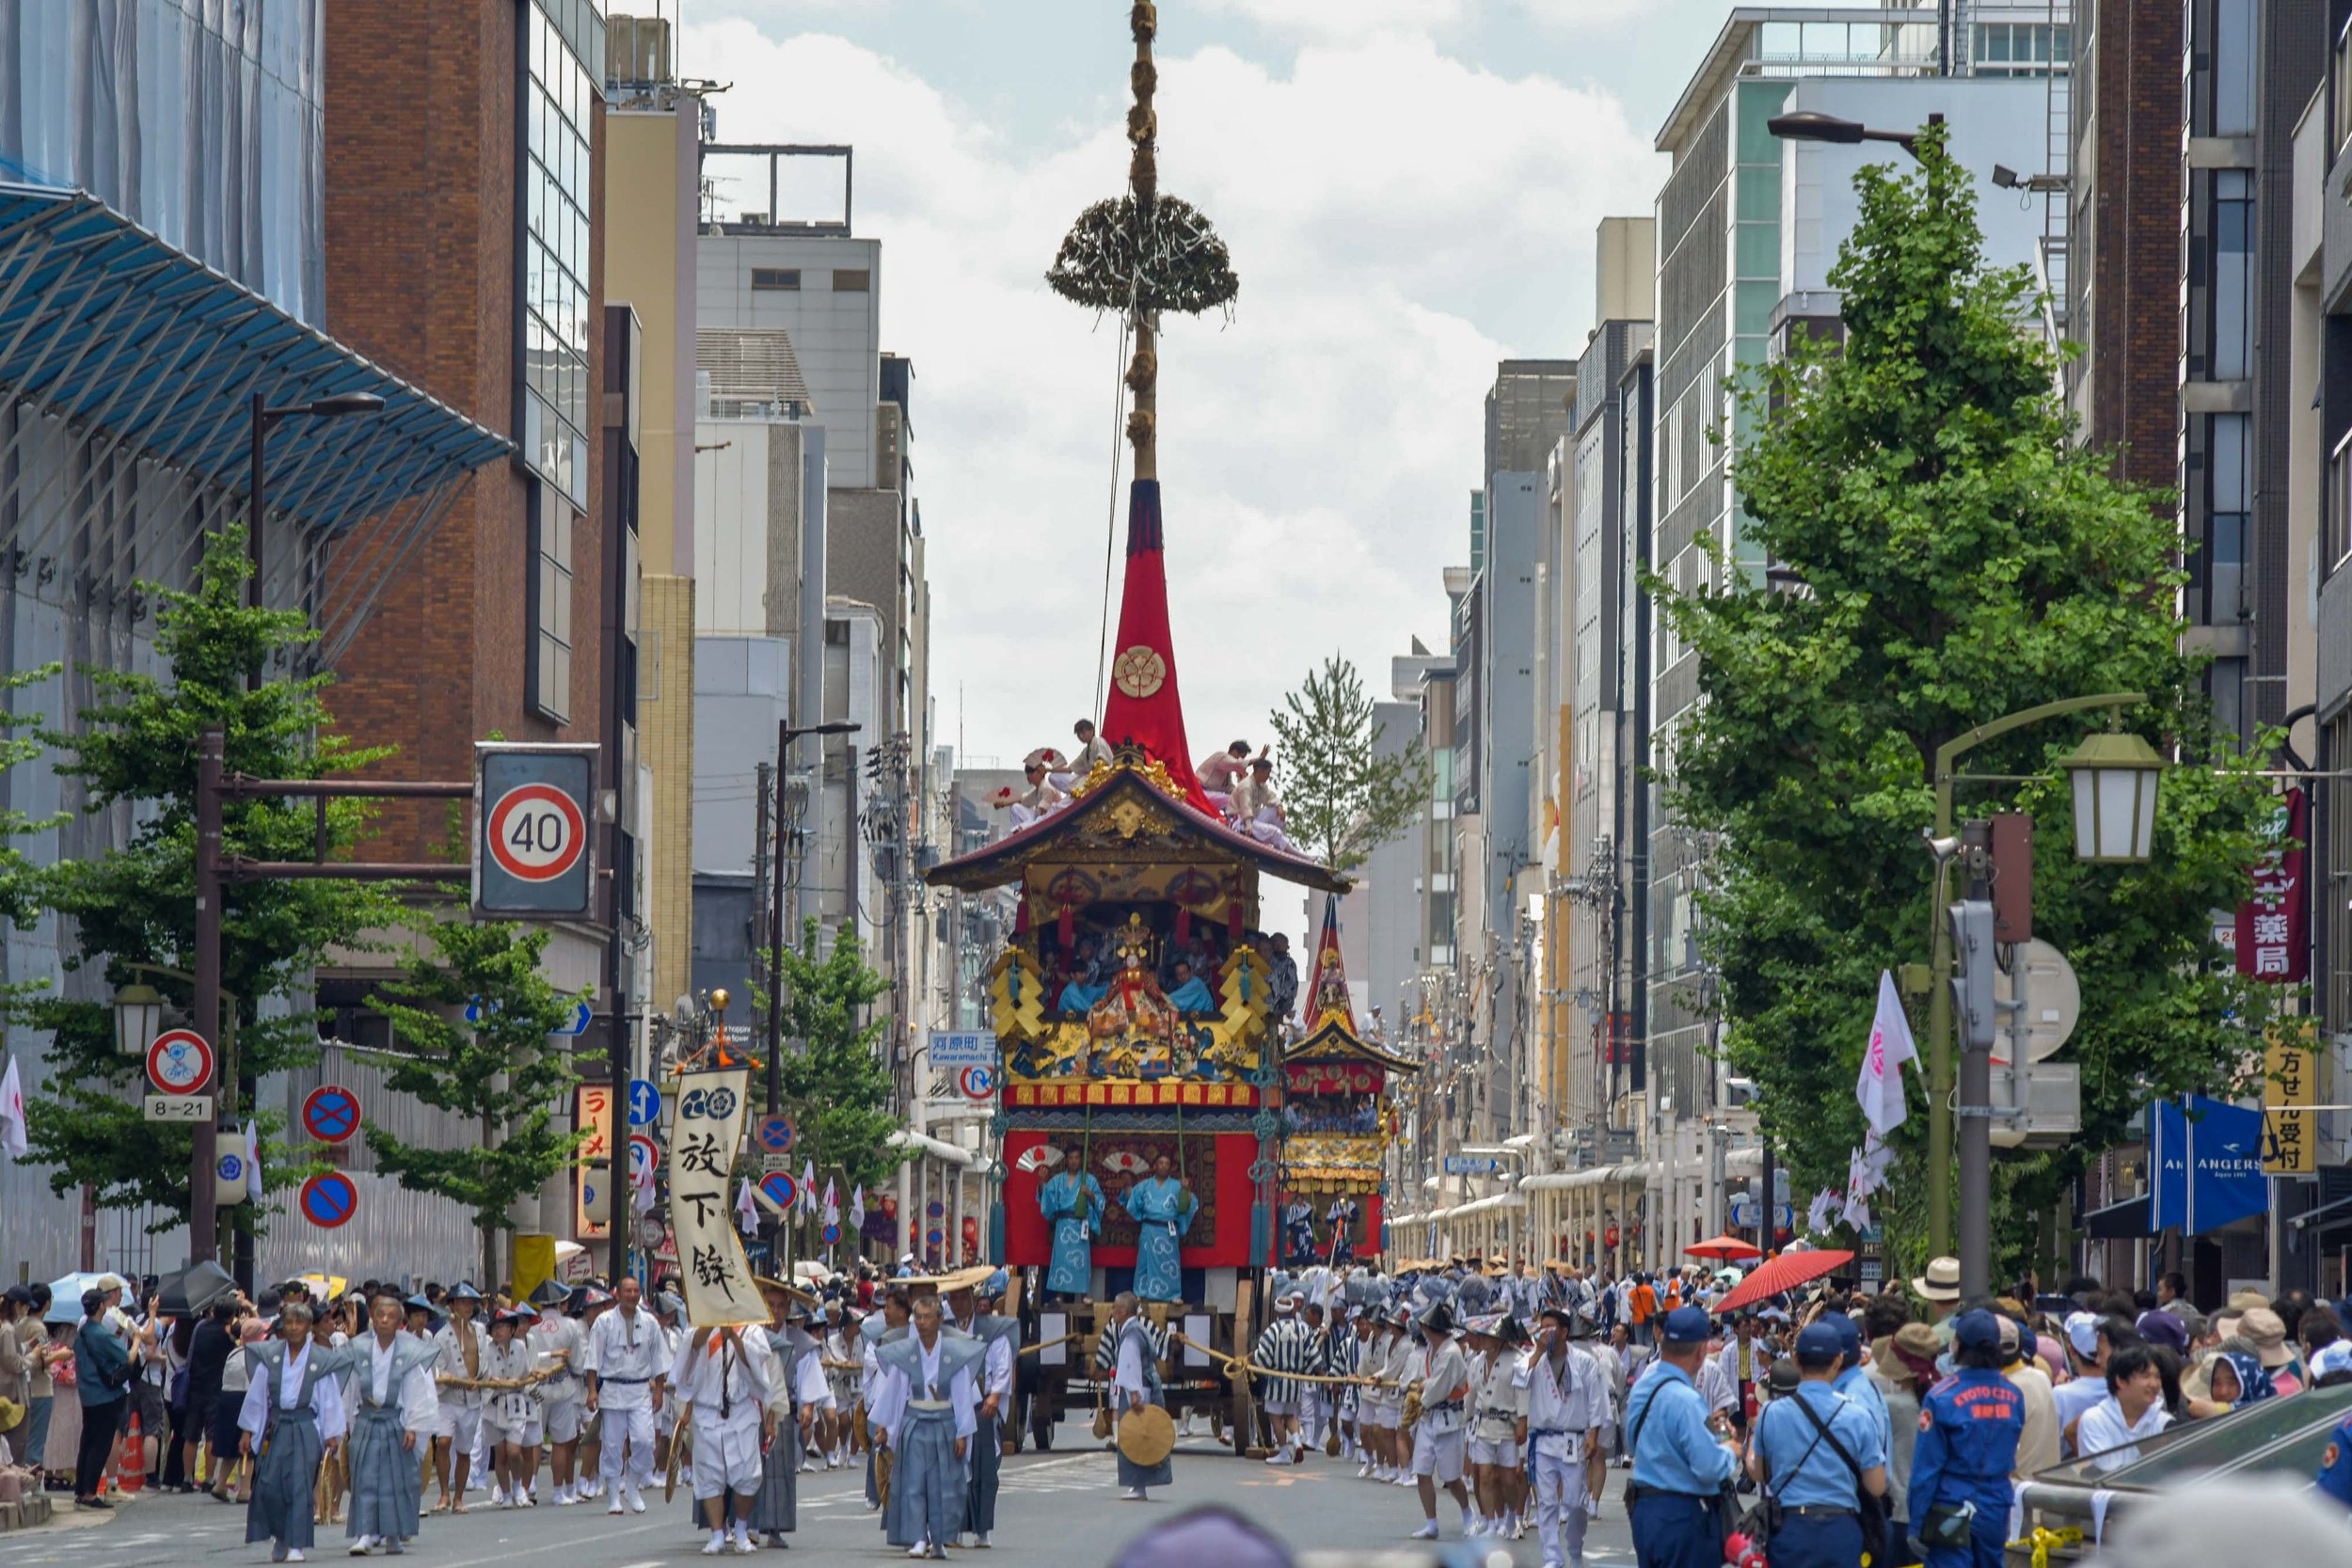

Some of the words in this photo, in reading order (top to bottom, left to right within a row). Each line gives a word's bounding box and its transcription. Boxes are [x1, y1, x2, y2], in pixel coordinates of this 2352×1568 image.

[511, 812, 562, 854] 40
[932, 1053, 987, 1062] Kawaramachi
[154, 1101, 203, 1117] 8-21
[585, 1091, 605, 1155] ラーメ
[2198, 1158, 2262, 1171] ANGERS
[678, 1132, 735, 1304] 放下鉾
[1953, 1385, 1991, 1407] KYOTO
[1992, 1386, 2019, 1404] CITY
